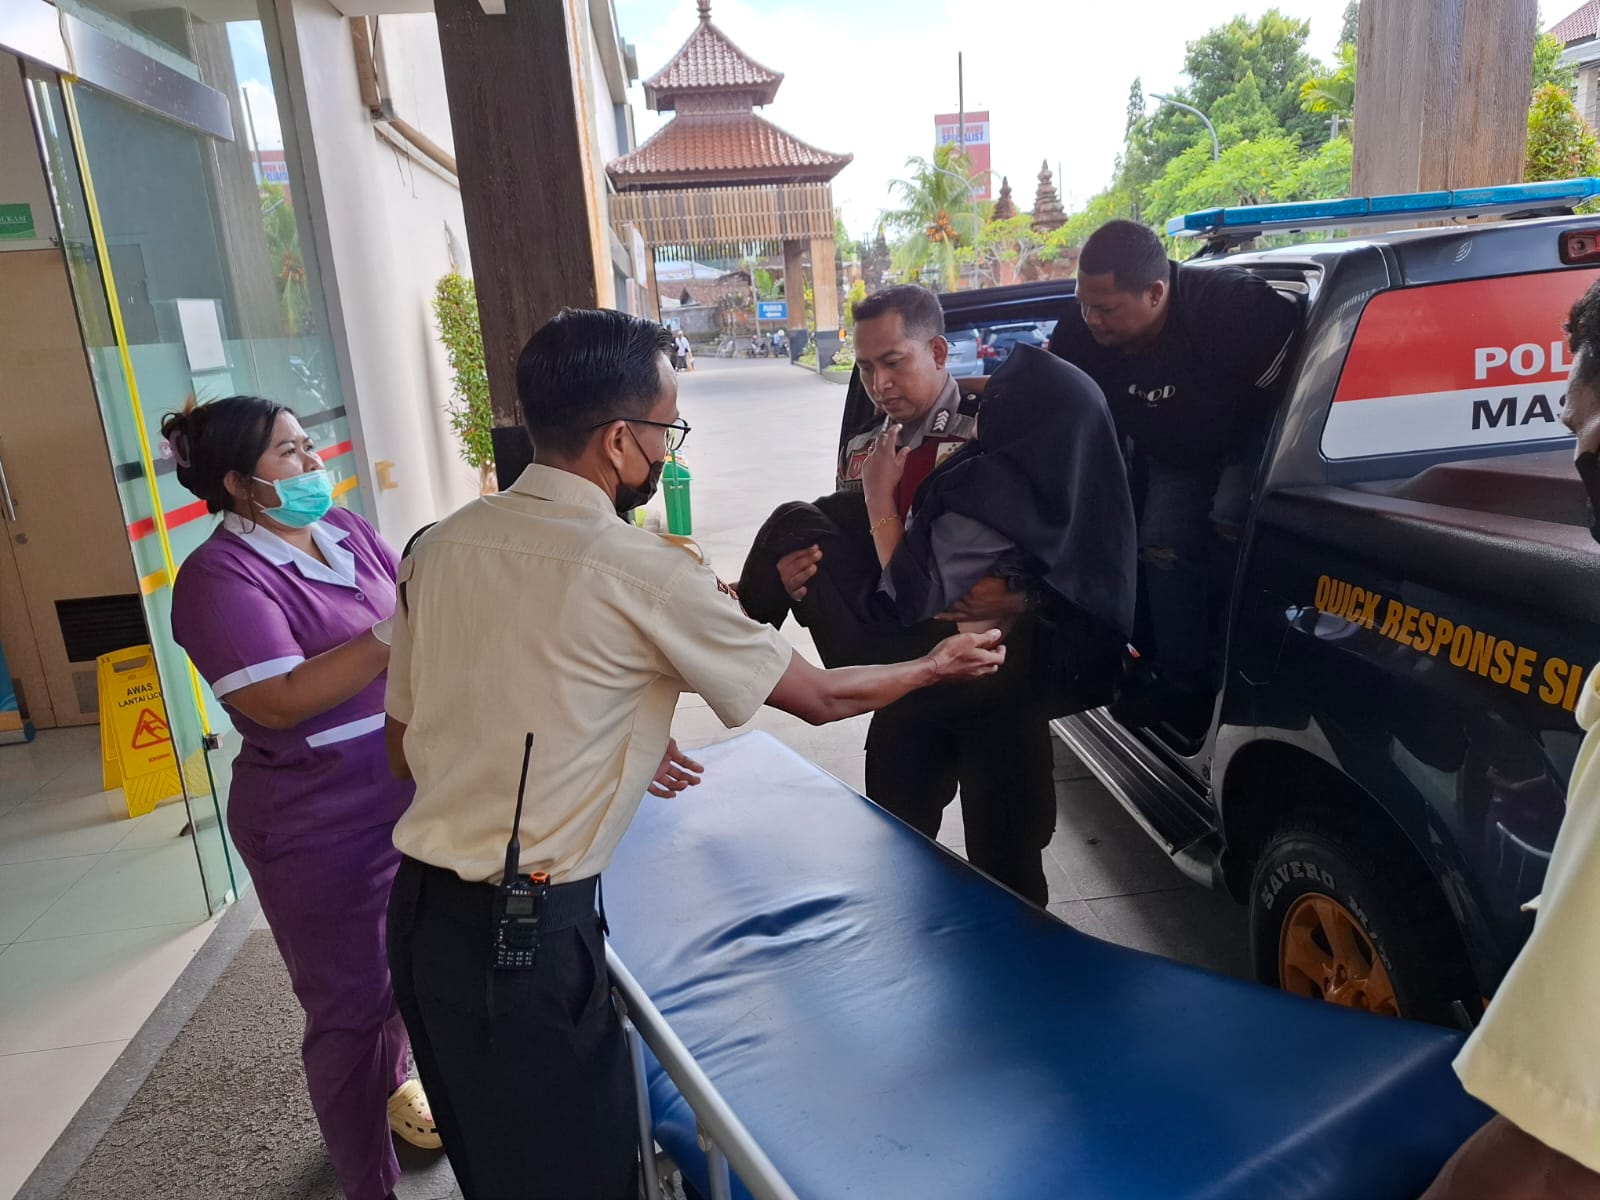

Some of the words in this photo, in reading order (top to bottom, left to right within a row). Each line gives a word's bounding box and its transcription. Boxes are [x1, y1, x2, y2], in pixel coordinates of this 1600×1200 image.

[1314, 574, 1382, 629] QUICK
[1379, 598, 1537, 694] RESPONSE
[118, 695, 146, 708] LANTAI
[127, 682, 154, 697] AWAS
[1261, 860, 1336, 911] SAVERO
